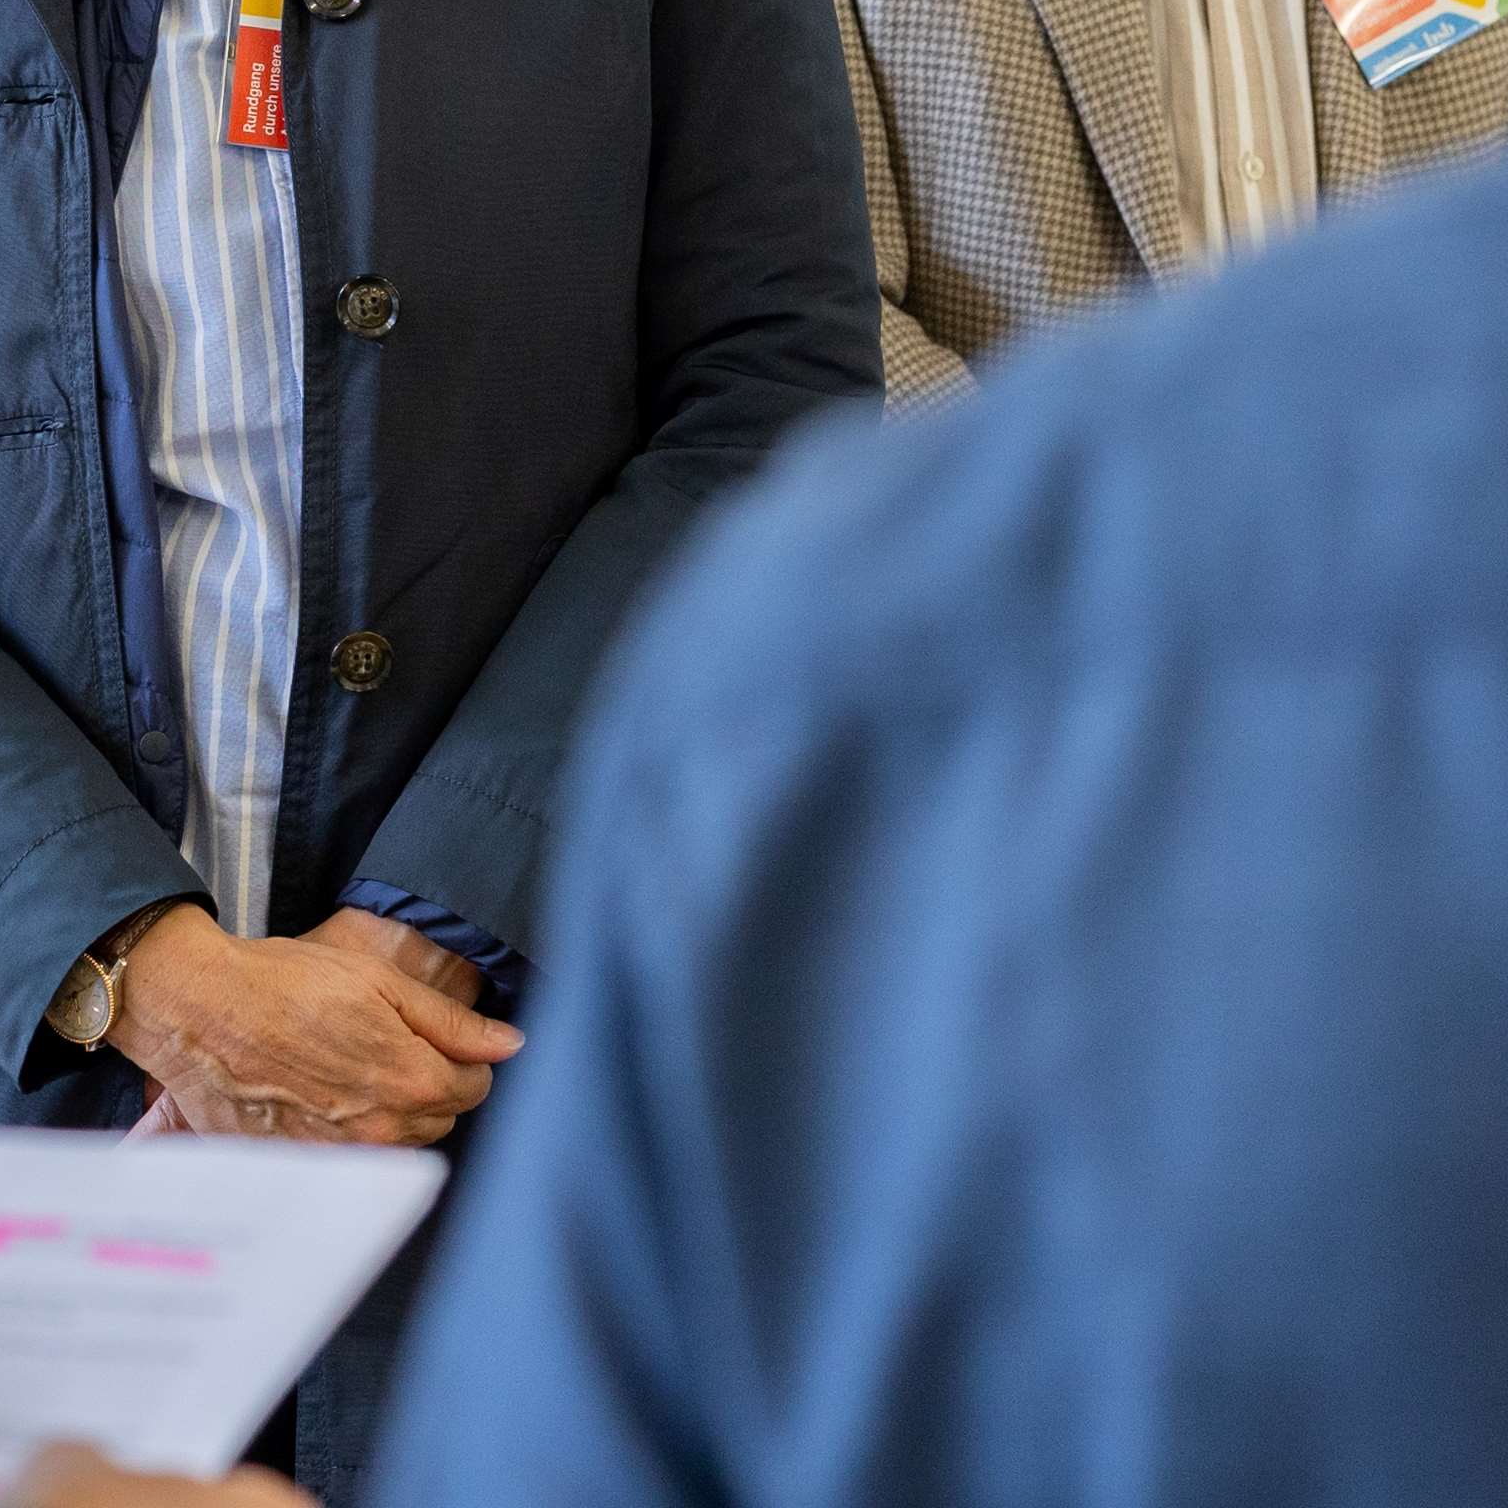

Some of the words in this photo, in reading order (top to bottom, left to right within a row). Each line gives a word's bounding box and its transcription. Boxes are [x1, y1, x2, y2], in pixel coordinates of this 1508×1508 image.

[269, 44, 282, 91] unsere
[243, 63, 265, 133] Rundgang
[262, 95, 279, 136] durch
